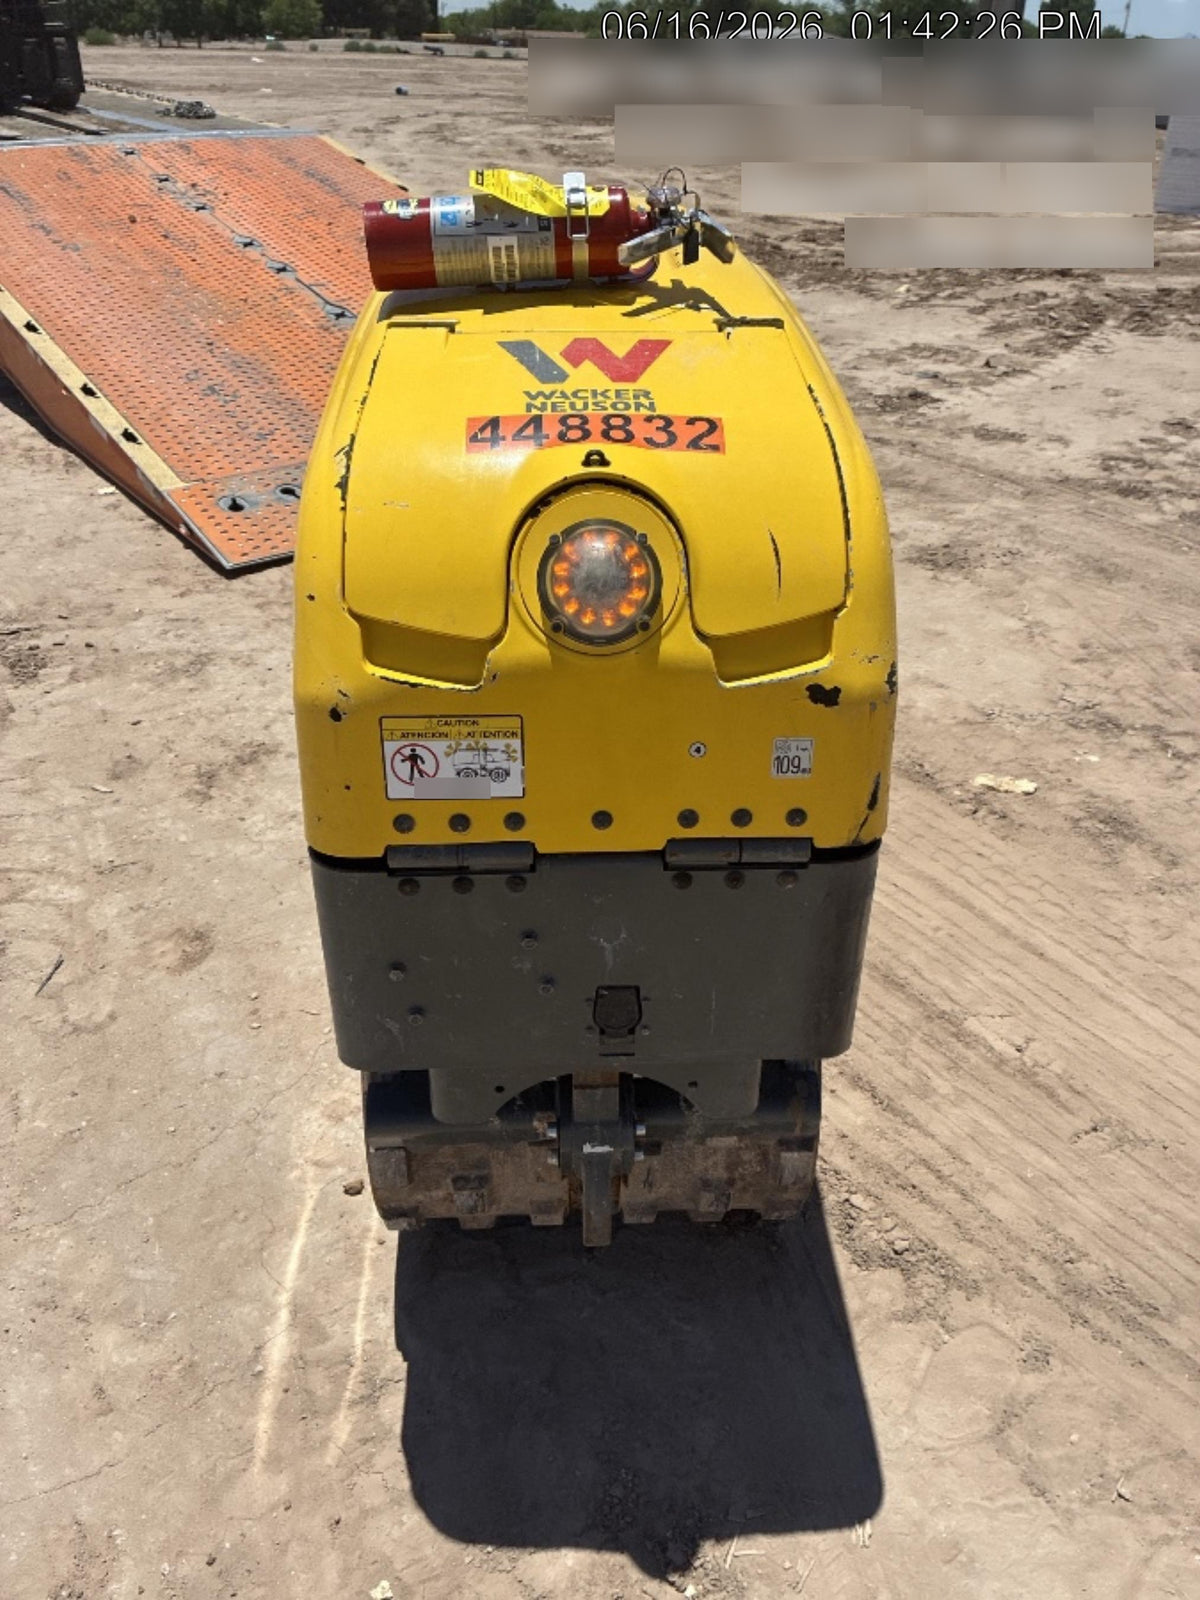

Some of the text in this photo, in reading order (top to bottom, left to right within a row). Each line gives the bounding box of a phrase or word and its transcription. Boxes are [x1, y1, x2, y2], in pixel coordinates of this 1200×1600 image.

[522, 388, 654, 400] WACKER
[525, 401, 657, 413] NEUSON
[468, 413, 721, 451] 448832
[436, 719, 480, 727] CAUTION
[465, 730, 519, 739] ATTENTION
[773, 755, 801, 775] 109
